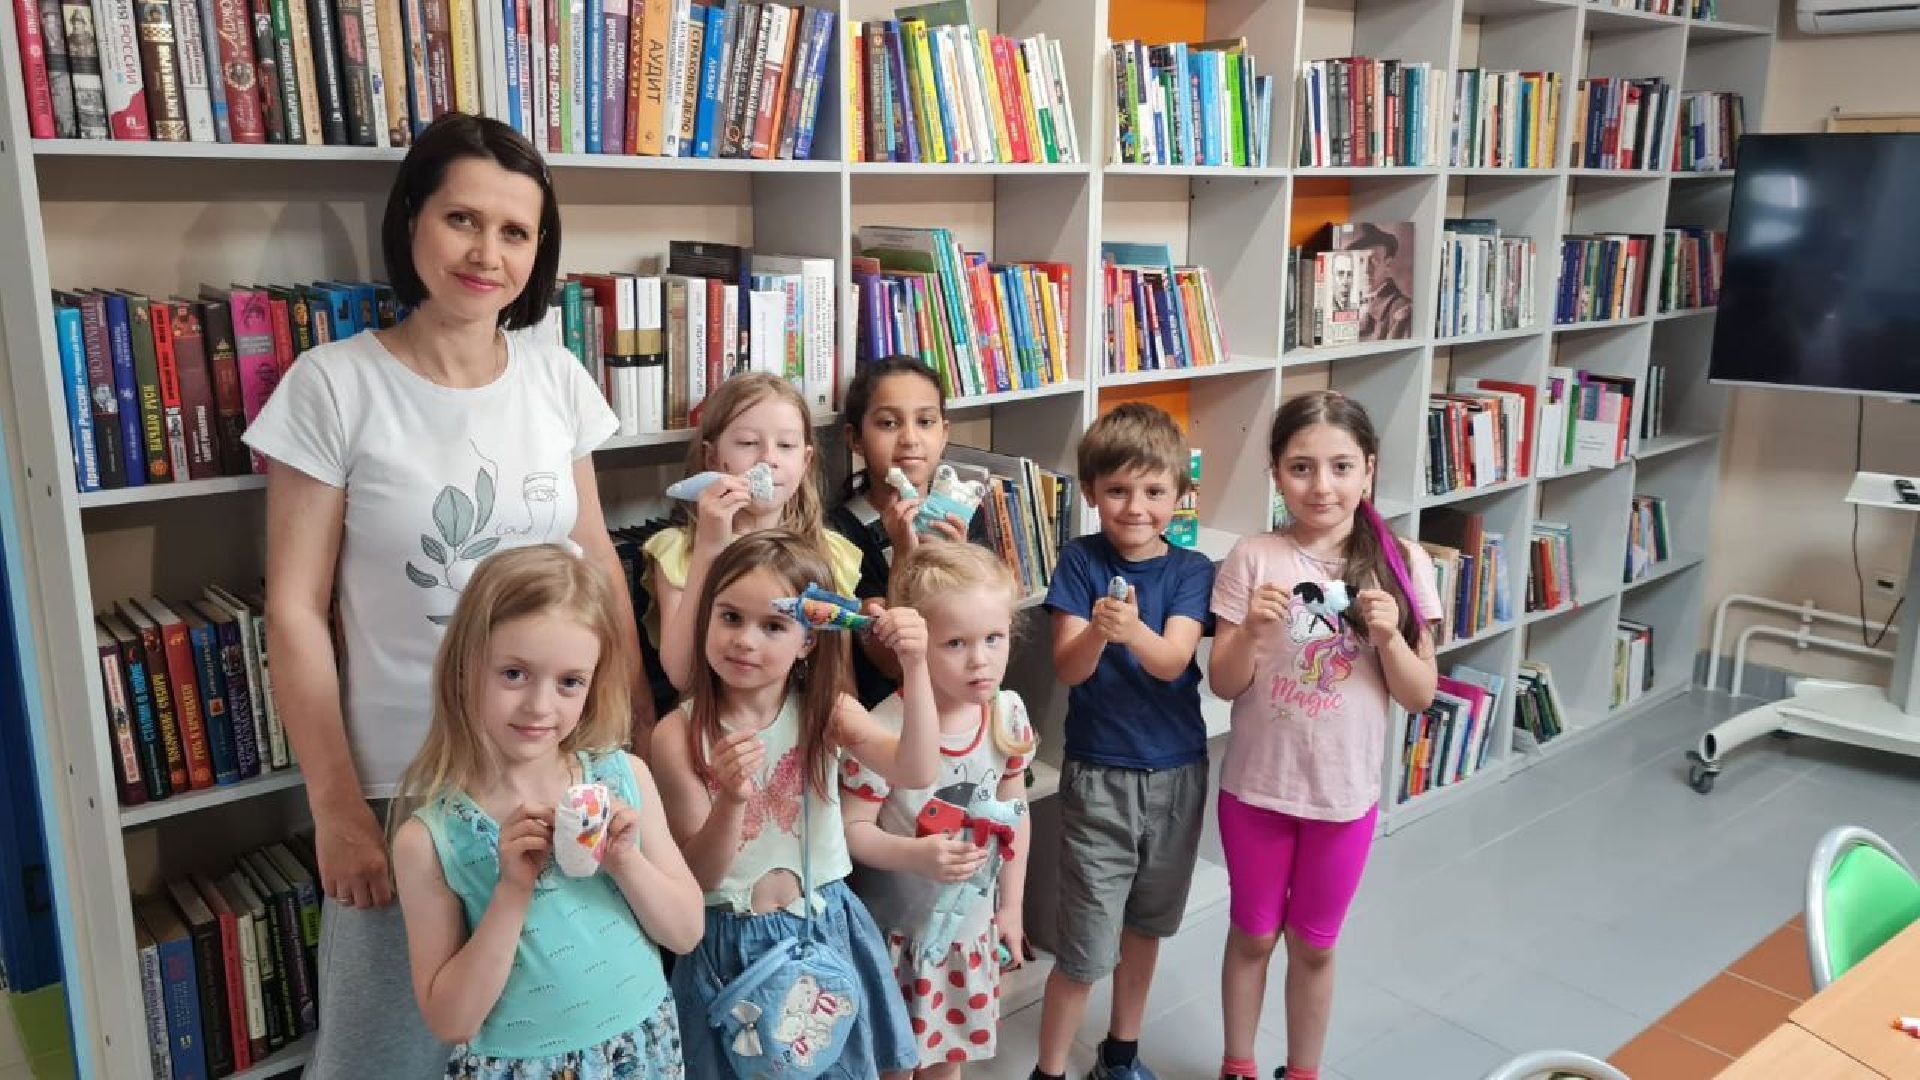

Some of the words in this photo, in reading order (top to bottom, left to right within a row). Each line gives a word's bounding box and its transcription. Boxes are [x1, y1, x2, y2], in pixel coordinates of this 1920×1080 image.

[120, 24, 138, 85] РОССИИ
[649, 39, 663, 106] АУДИТ
[686, 29, 702, 98] СТРАХОВОЕ
[682, 100, 694, 133] ДЕЛО
[1271, 674, 1345, 719] Magic
